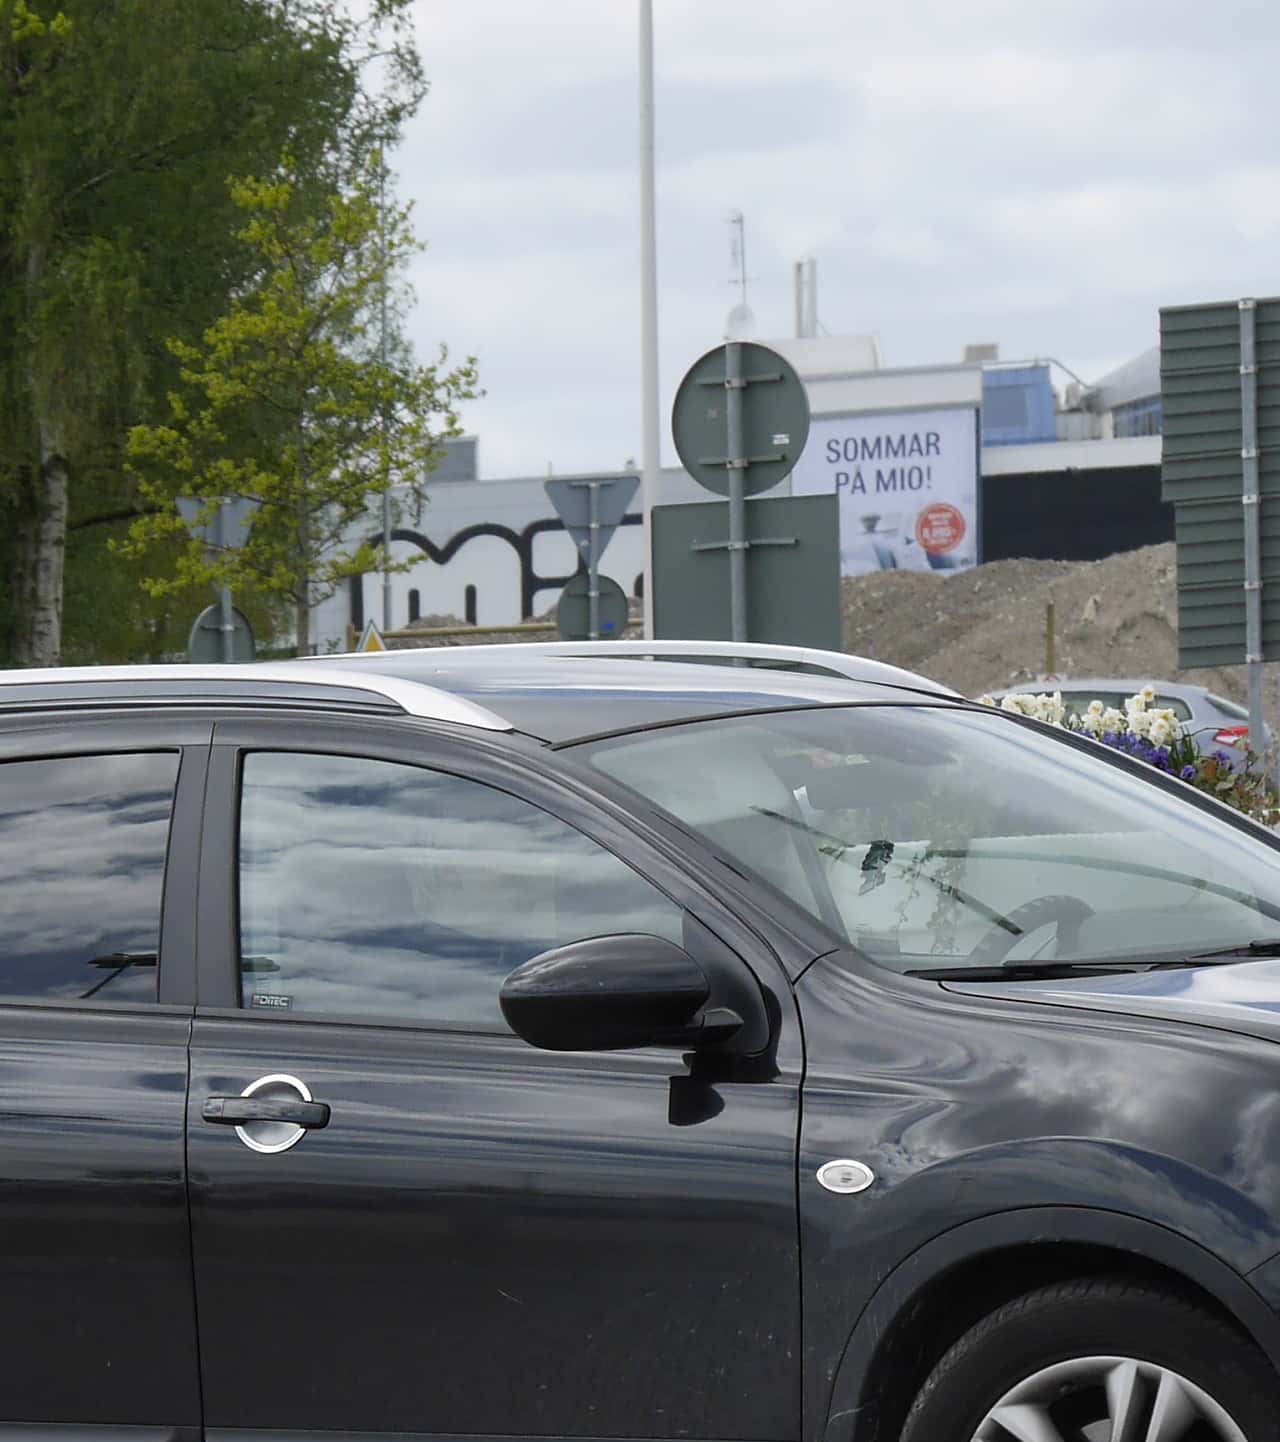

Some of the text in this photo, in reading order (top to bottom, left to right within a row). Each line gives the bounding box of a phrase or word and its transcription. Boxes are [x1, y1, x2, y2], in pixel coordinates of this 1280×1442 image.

[826, 431, 941, 464] SOMMAR
[835, 465, 933, 495] PÅ MIO!
